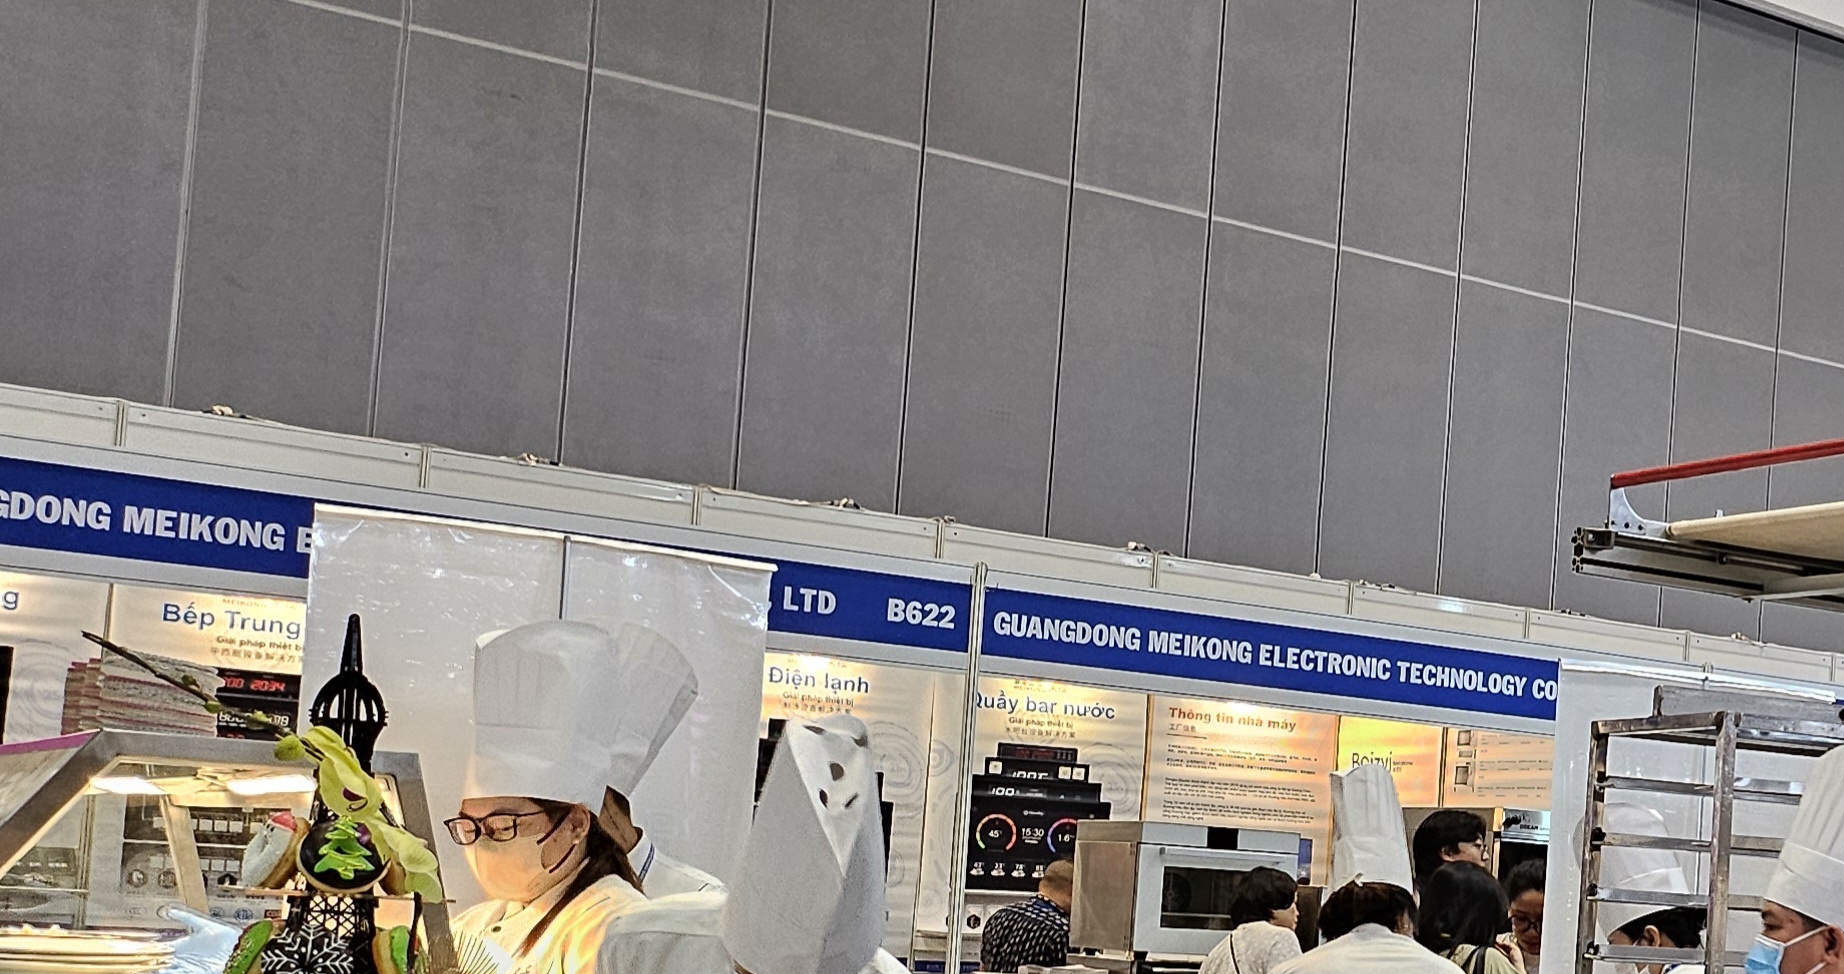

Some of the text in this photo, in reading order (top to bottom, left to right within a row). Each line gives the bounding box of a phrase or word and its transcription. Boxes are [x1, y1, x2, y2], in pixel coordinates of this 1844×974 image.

[123, 505, 286, 551] MEIKONG
[162, 602, 301, 640] Bếp Trung
[783, 586, 956, 630] LTD B622
[993, 611, 1141, 651] GUANGDONG
[1148, 631, 1253, 664] MEIKONG
[1258, 643, 1392, 681] ELECTRONIC
[1397, 660, 1527, 697] TECHNOLOGY
[769, 667, 869, 694] Điện lạnh
[1026, 696, 1056, 714] bar
[1063, 702, 1115, 719] nước
[1267, 717, 1297, 733] máy
